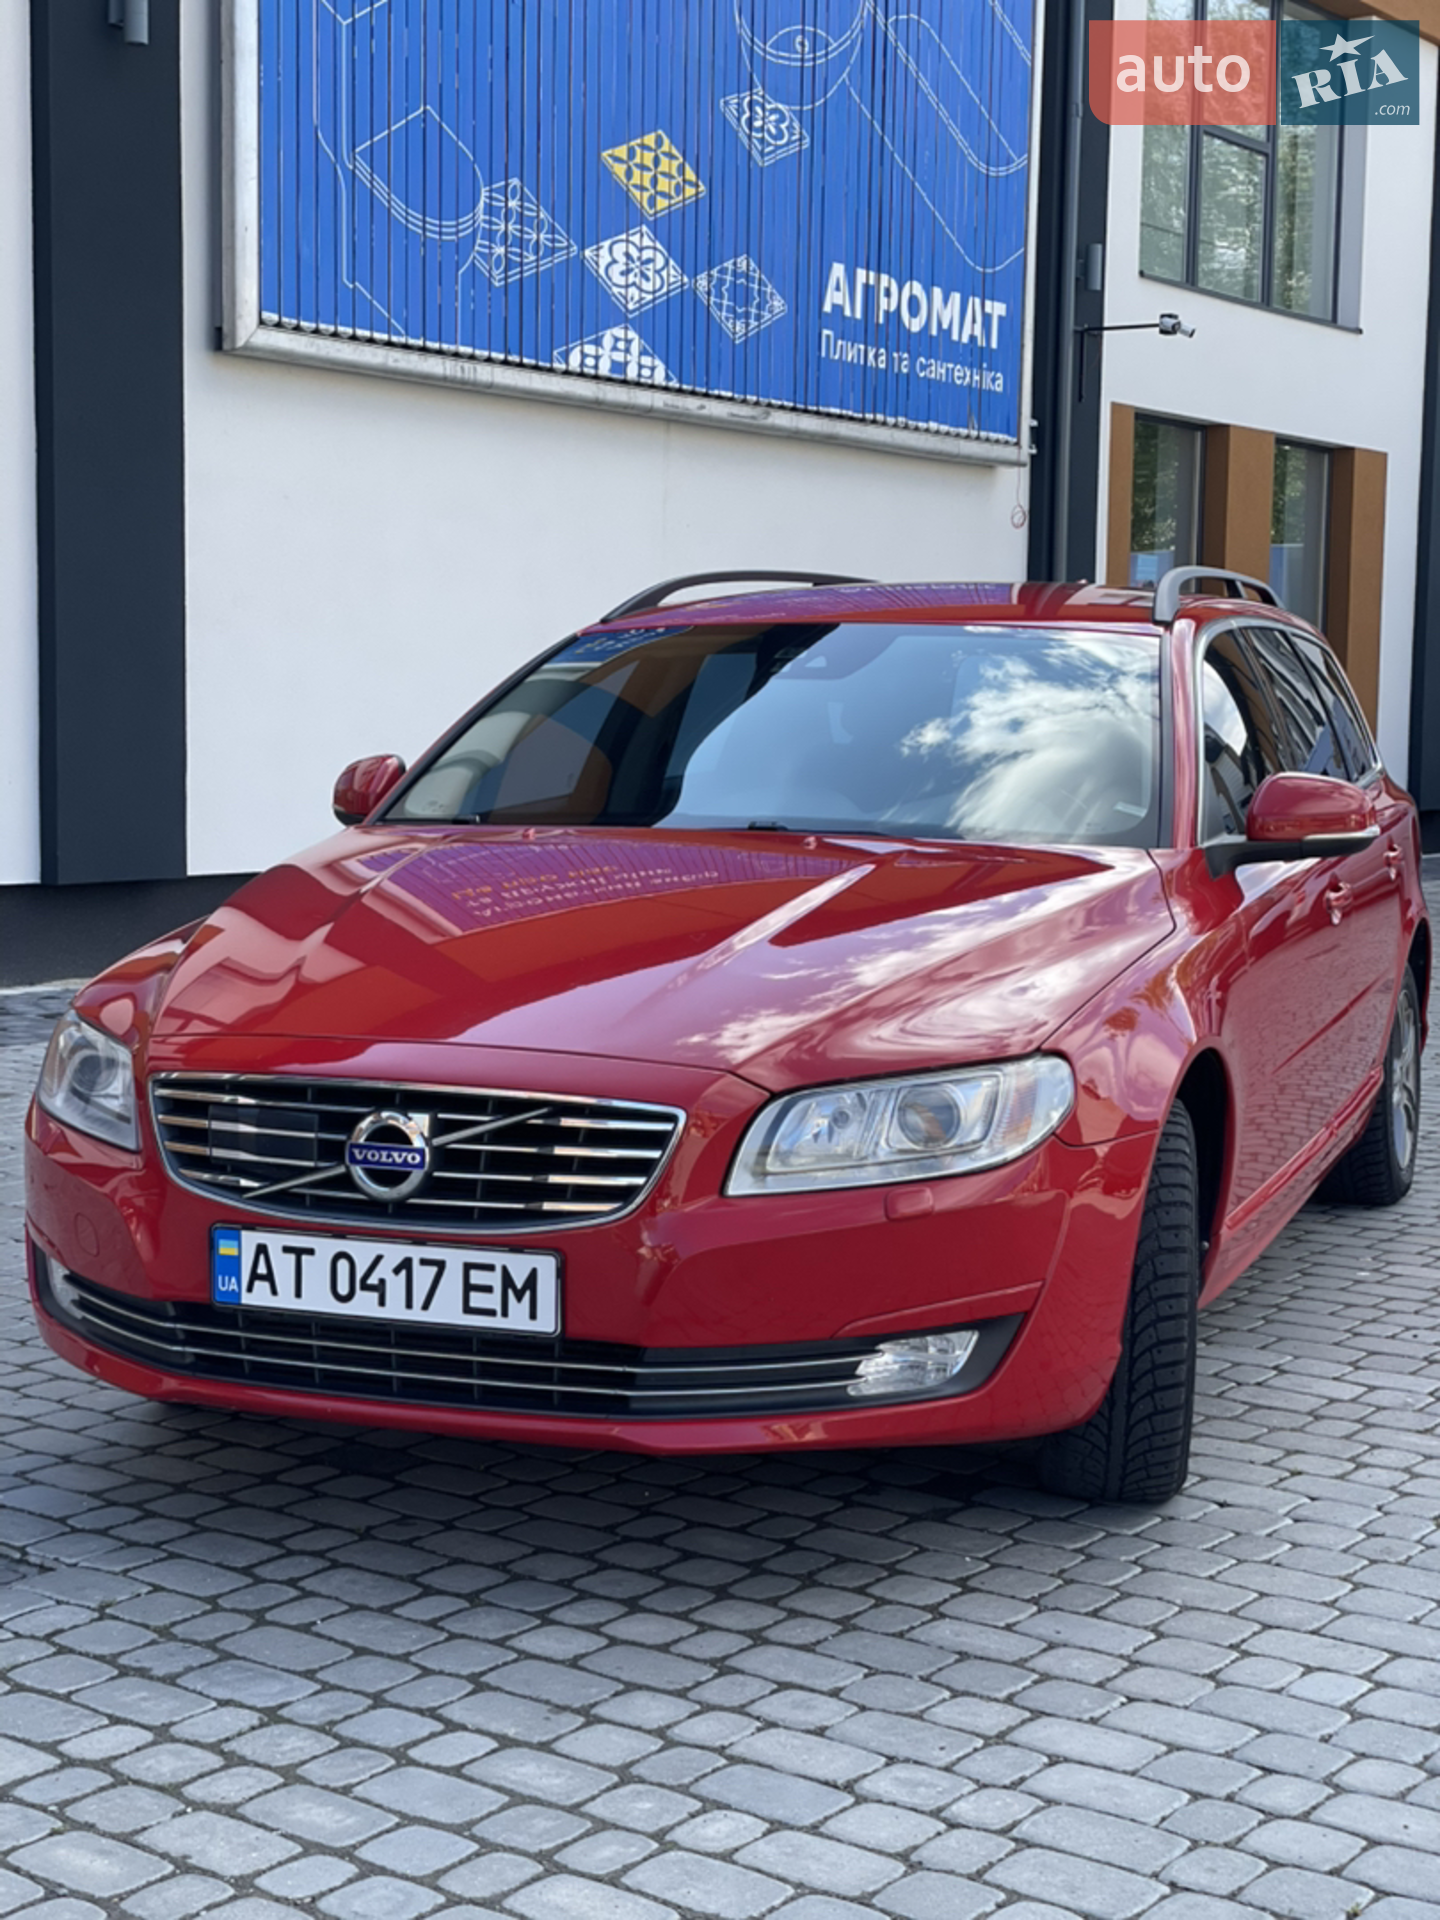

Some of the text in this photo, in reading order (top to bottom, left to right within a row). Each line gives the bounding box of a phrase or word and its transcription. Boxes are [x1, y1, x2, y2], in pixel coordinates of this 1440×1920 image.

[822, 261, 1007, 350] АГРОМАТ
[821, 328, 1003, 393] Плитка та сантехніка
[353, 1149, 421, 1164] VOLVO
[218, 1275, 239, 1292] UA
[246, 1243, 538, 1321] AT 0417 EM
